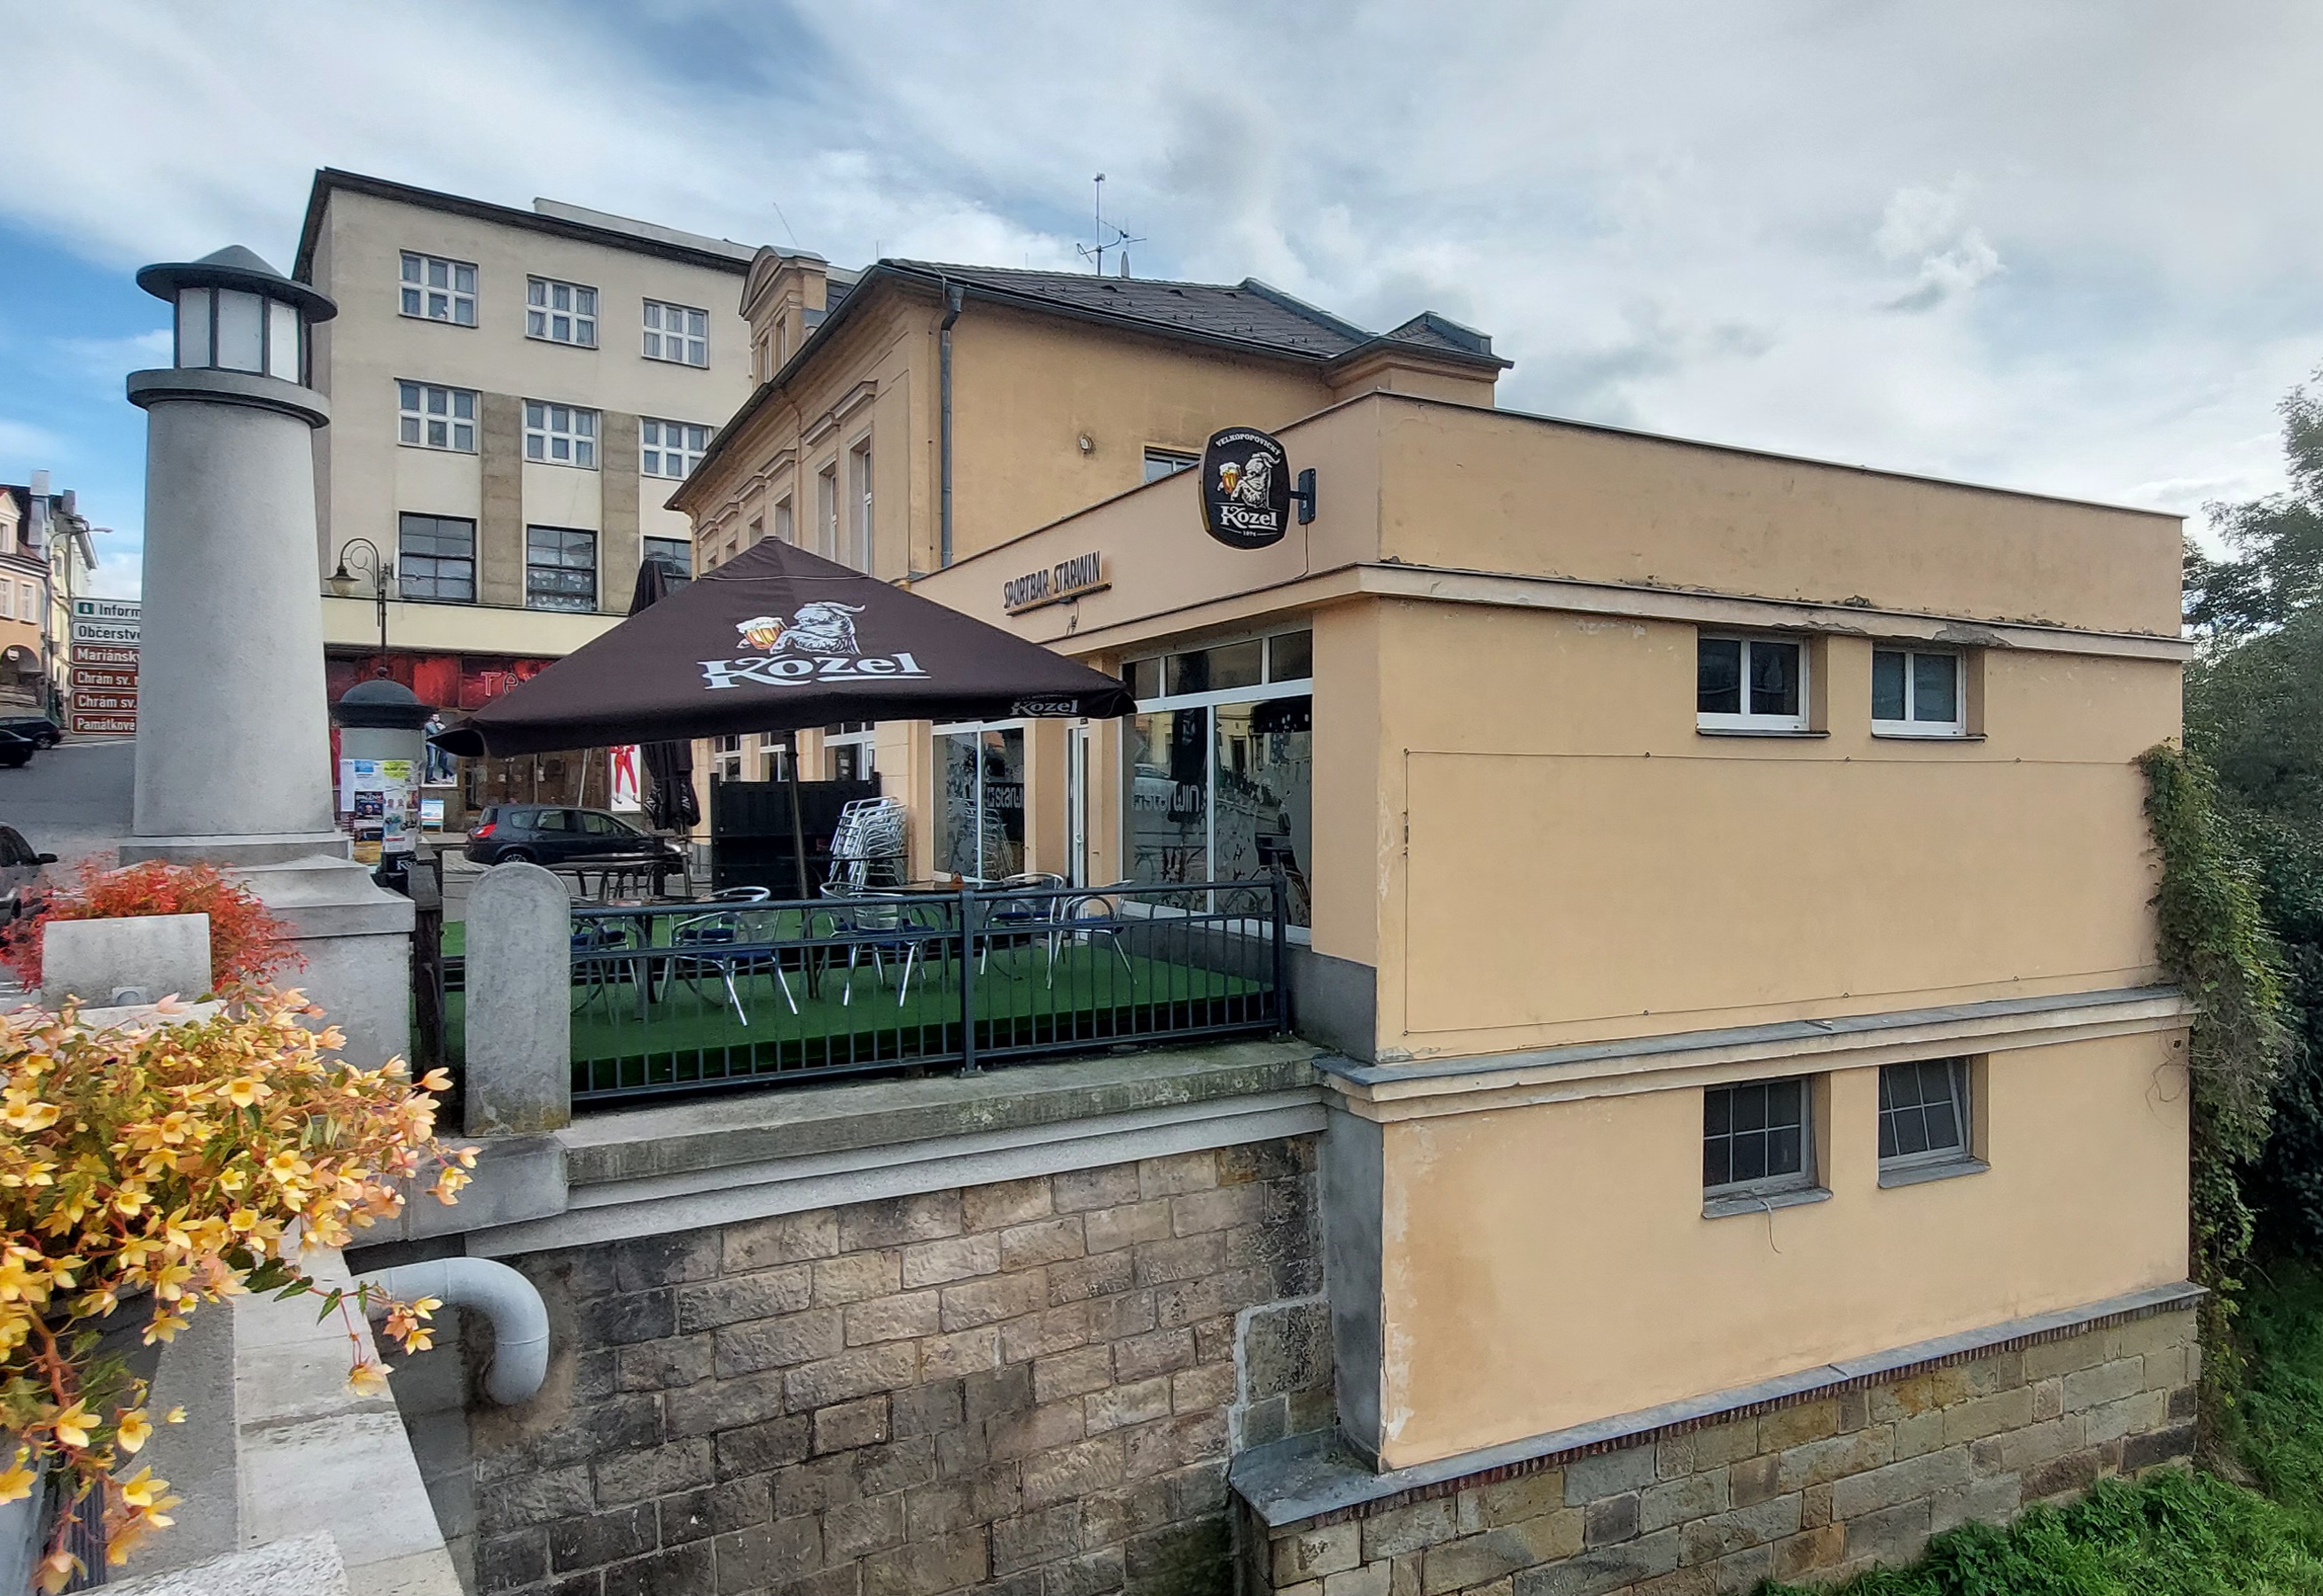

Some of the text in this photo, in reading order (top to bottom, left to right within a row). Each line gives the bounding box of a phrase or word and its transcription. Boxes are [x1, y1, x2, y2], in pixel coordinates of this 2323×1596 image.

[1220, 505, 1278, 529] Kozel
[1004, 550, 1101, 609] SPORTBAR STARWIN
[99, 604, 141, 617] Inform
[77, 670, 113, 685] Chrám
[115, 676, 131, 685] sv.
[697, 653, 928, 690] Kozel
[78, 694, 137, 708] Chrám sv.
[1009, 700, 1078, 716] Kozel
[76, 717, 136, 732] Památkové
